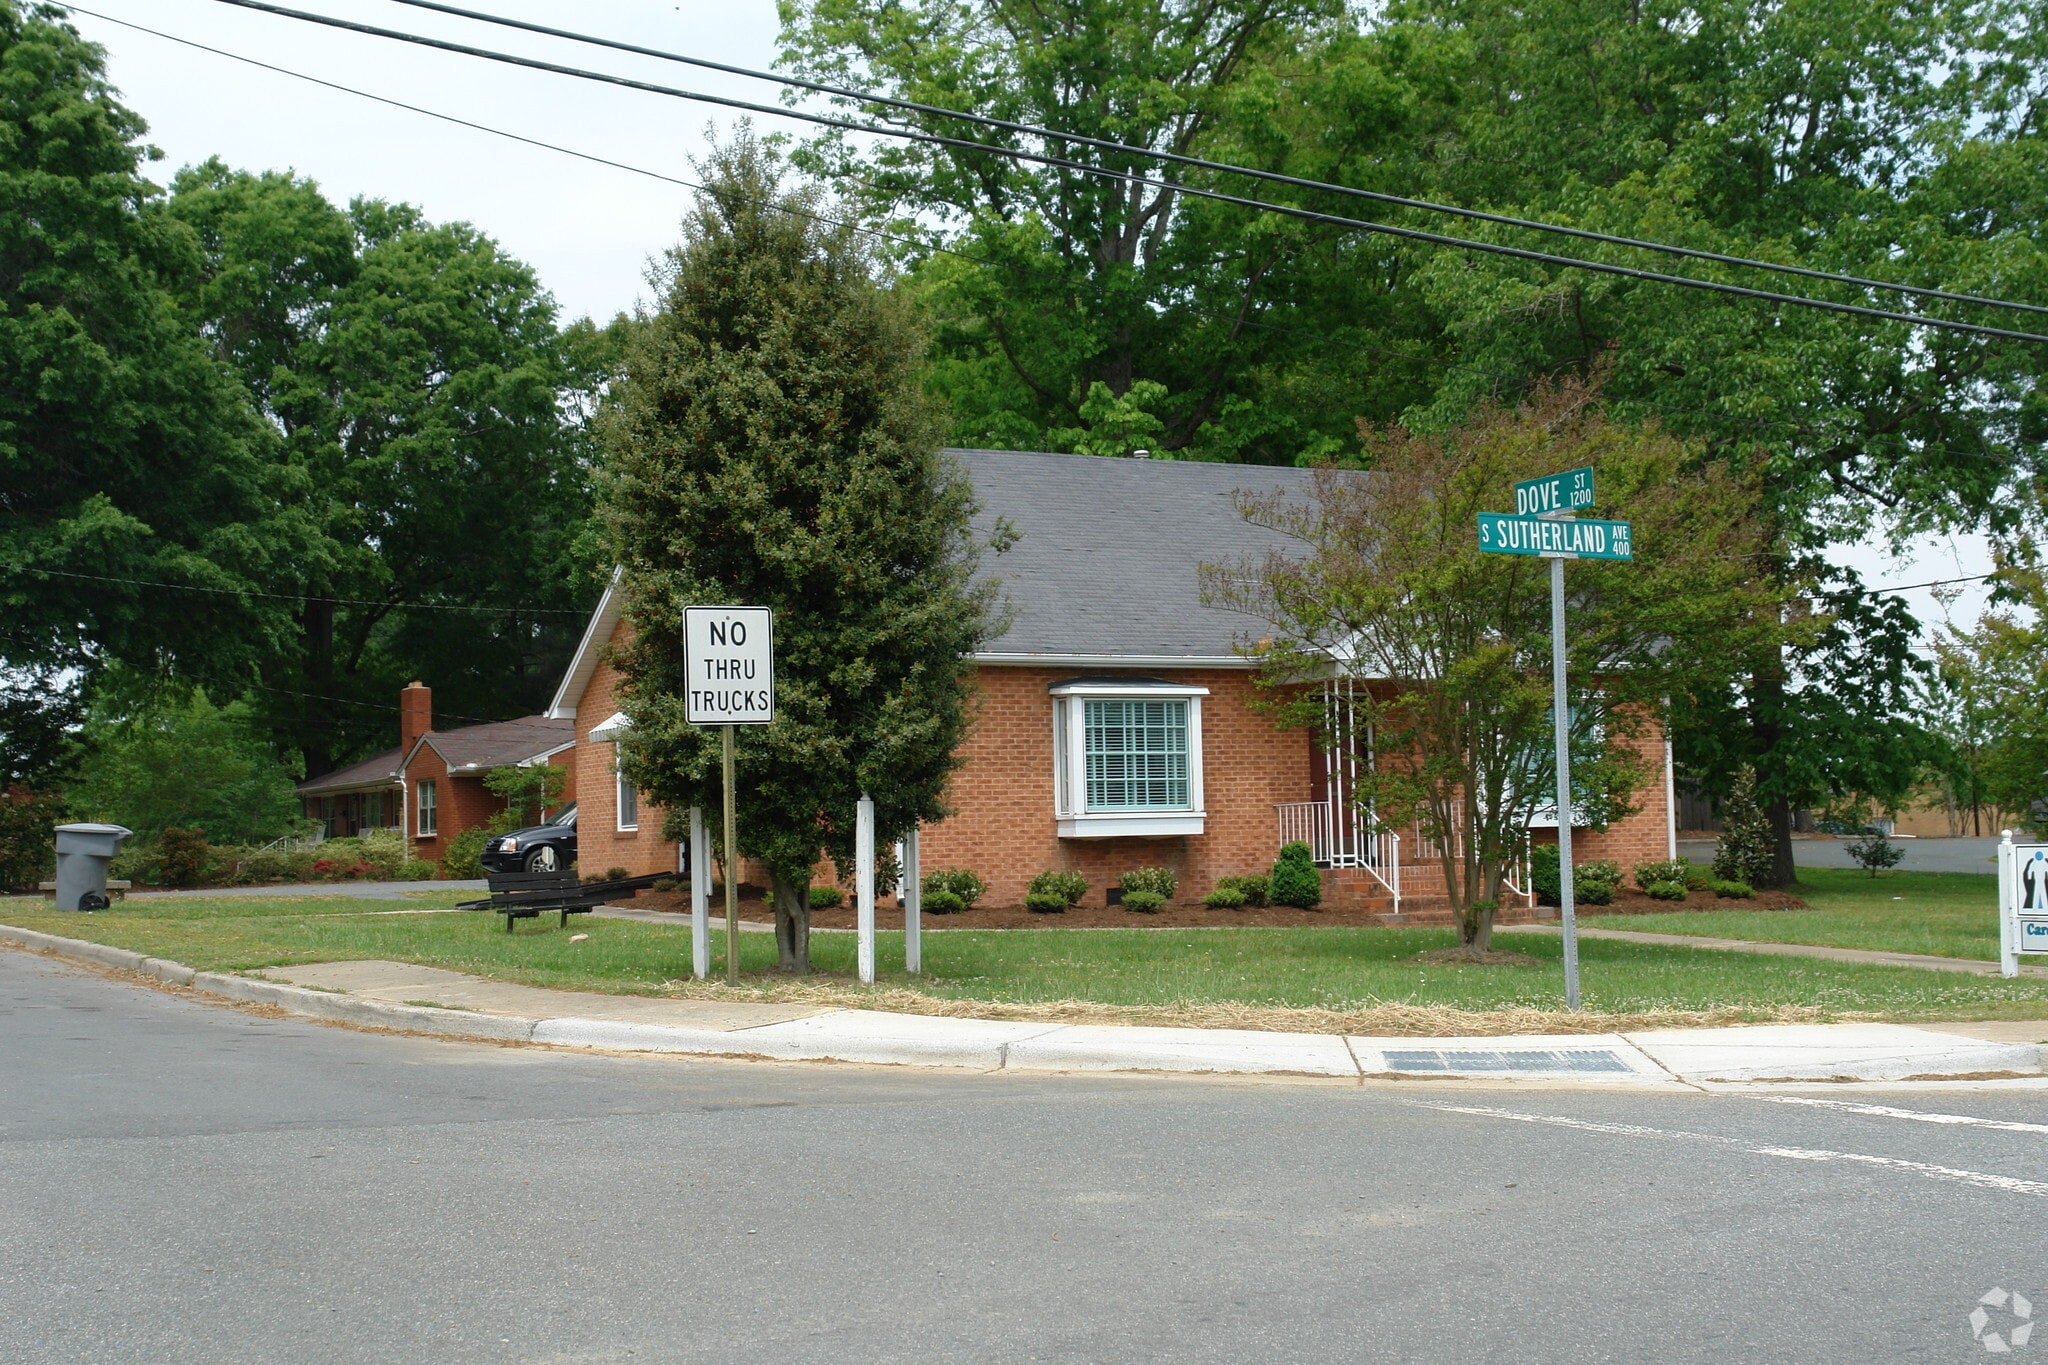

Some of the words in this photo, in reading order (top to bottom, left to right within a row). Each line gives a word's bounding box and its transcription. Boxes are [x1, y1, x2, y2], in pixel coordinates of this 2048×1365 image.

[1517, 480, 1561, 516] DOVE
[1574, 473, 1585, 489] ST
[1570, 488, 1592, 506] 1200
[1482, 523, 1490, 543] S
[1497, 519, 1606, 553] SUTHERLAND
[1612, 525, 1628, 540] AVE
[1612, 541, 1630, 556] 400
[710, 621, 747, 646] NO
[704, 659, 755, 680] THRU
[691, 690, 768, 711] TRUCKS
[2026, 923, 2048, 935] Car
